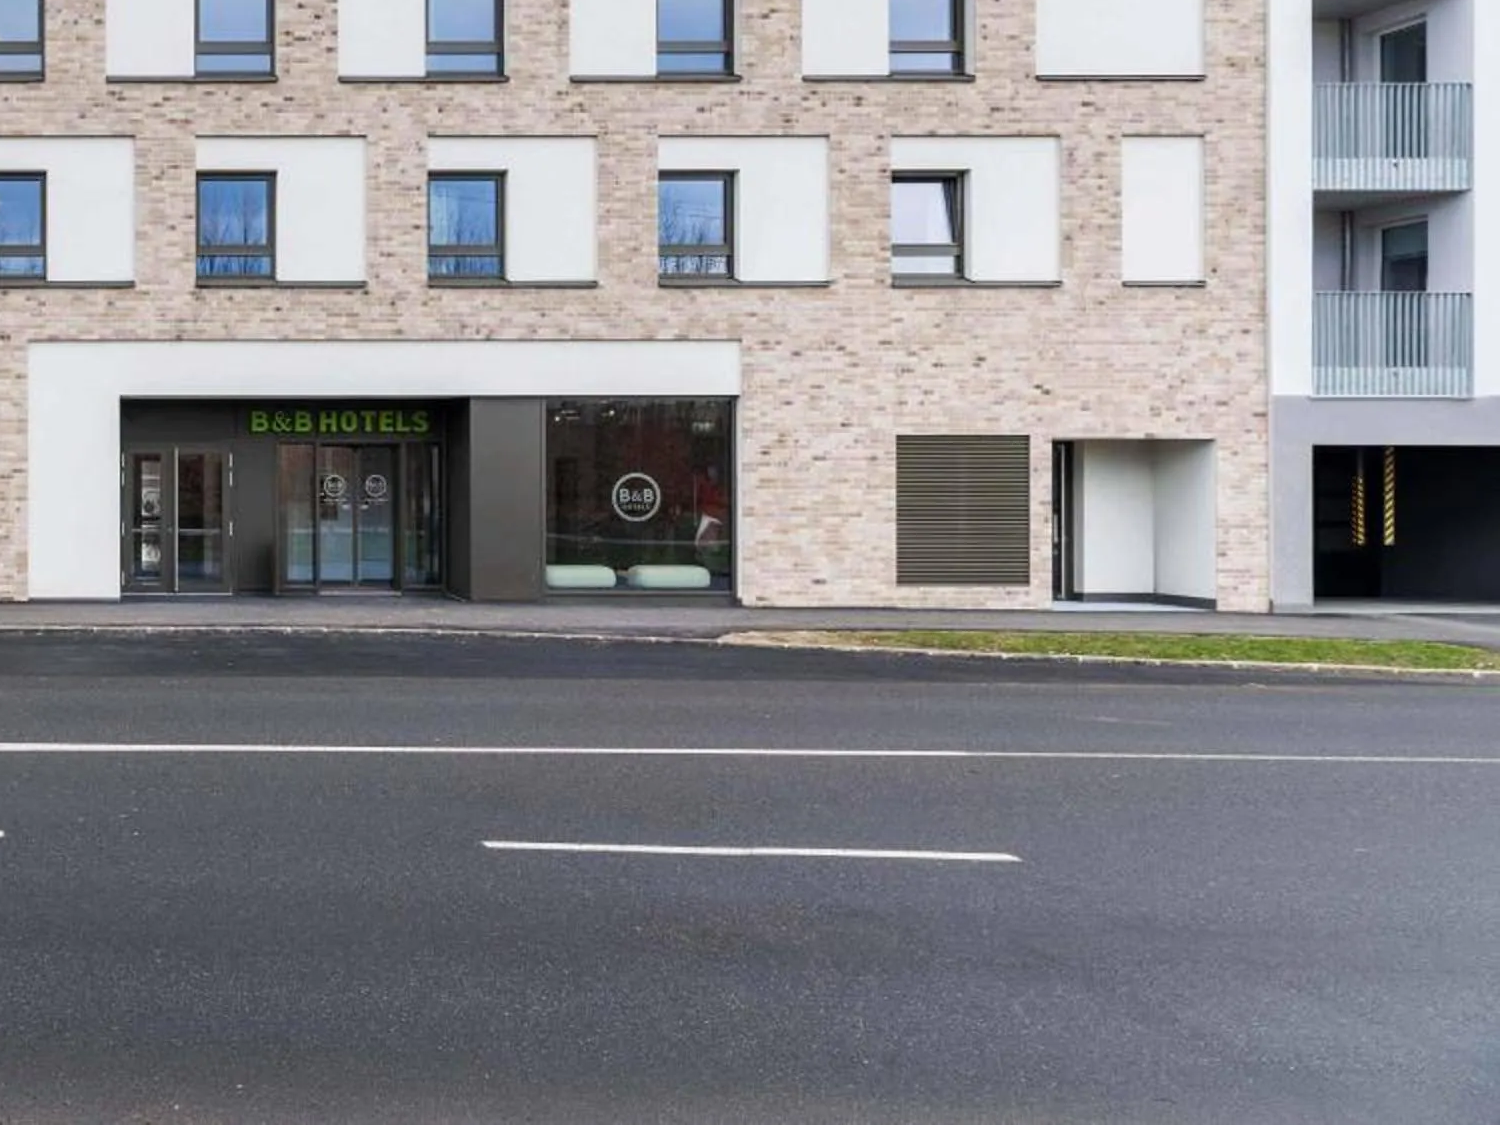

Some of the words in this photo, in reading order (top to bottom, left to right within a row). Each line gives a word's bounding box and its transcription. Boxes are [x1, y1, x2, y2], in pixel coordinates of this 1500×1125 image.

[251, 410, 312, 433] B&B
[319, 410, 429, 433] HOTELS
[619, 488, 654, 503] B&B
